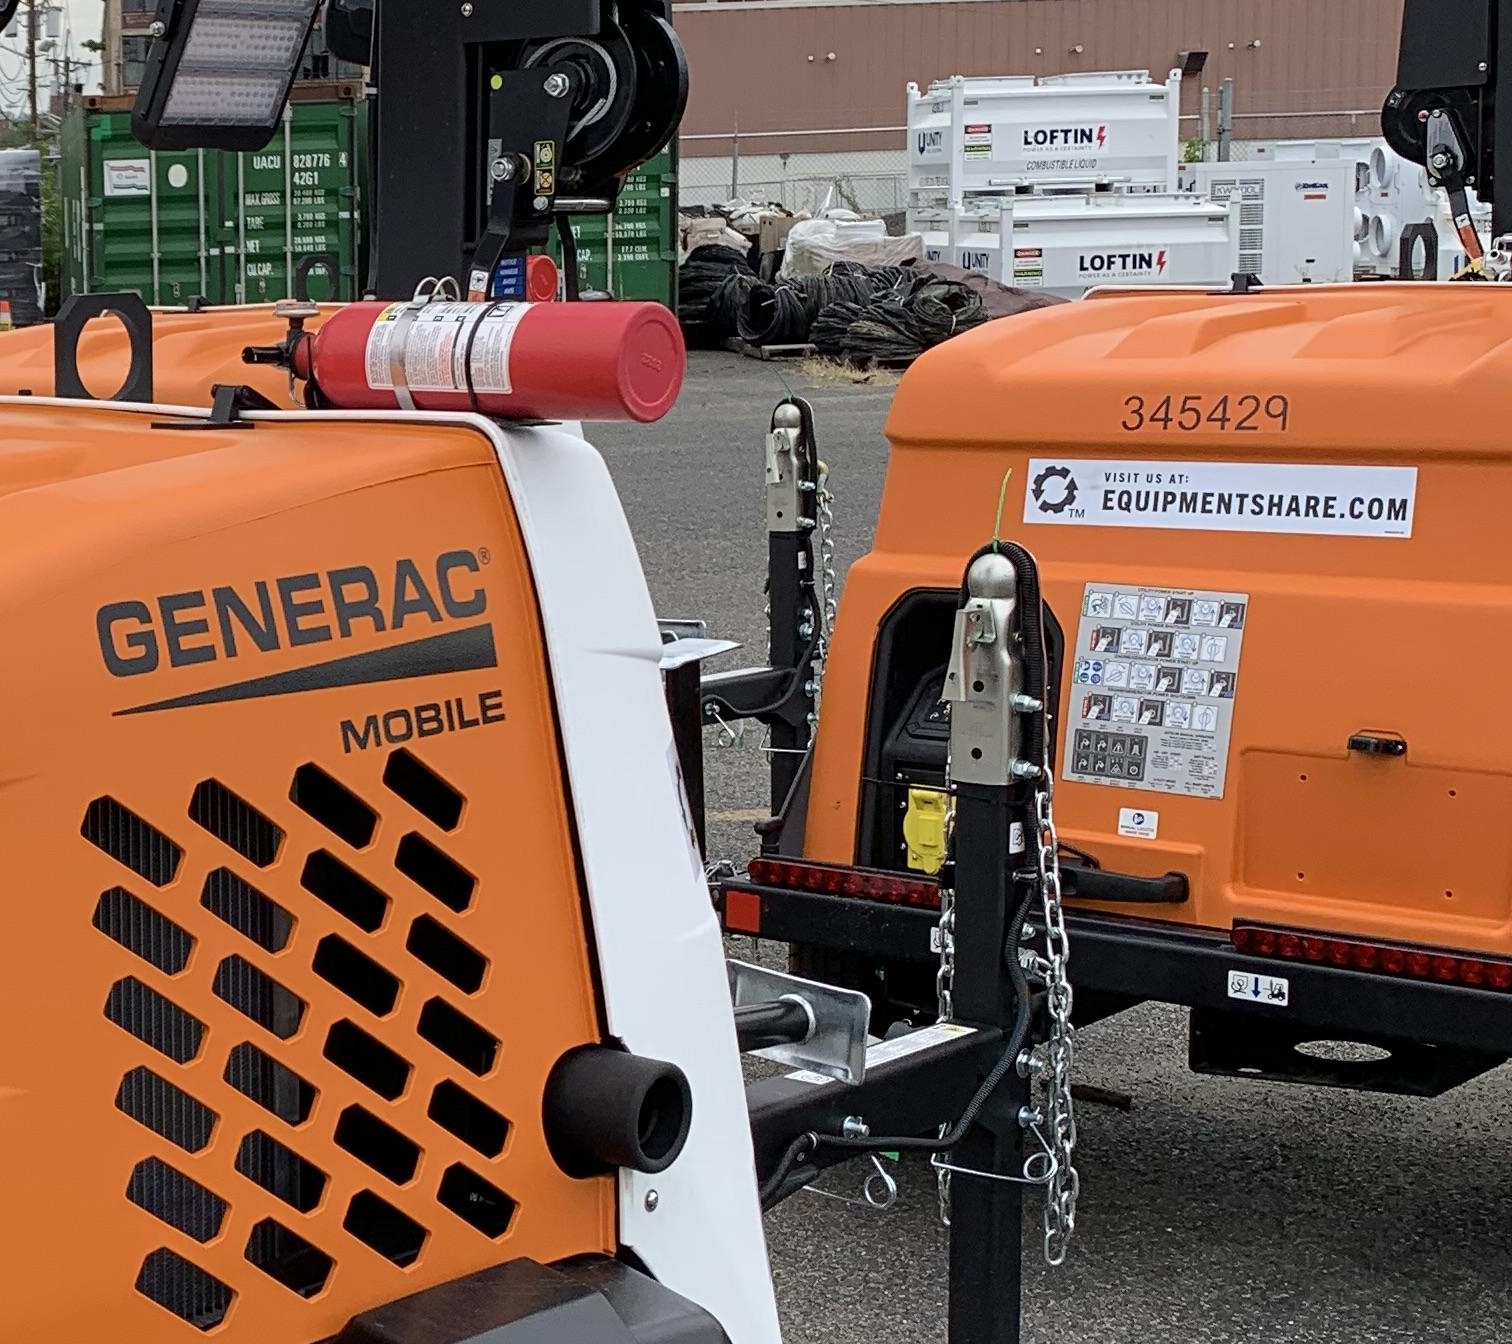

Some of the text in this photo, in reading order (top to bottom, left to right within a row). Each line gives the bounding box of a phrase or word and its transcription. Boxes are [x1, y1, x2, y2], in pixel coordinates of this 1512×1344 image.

[1024, 128, 1093, 145] LOFTIN
[253, 156, 281, 169] UACU
[293, 154, 330, 168] 828776
[1026, 158, 1097, 170] COMBUSTIBLE LIQUID
[293, 172, 318, 185] 42G1
[1080, 253, 1152, 271] LOFTIN
[1121, 394, 1289, 432] 345429
[1104, 472, 1190, 485] VISIT US AT:
[1101, 489, 1408, 522] EQUIPMENTSHARE.COM
[96, 549, 487, 677] GENERAC
[339, 690, 505, 754] MOBILE
